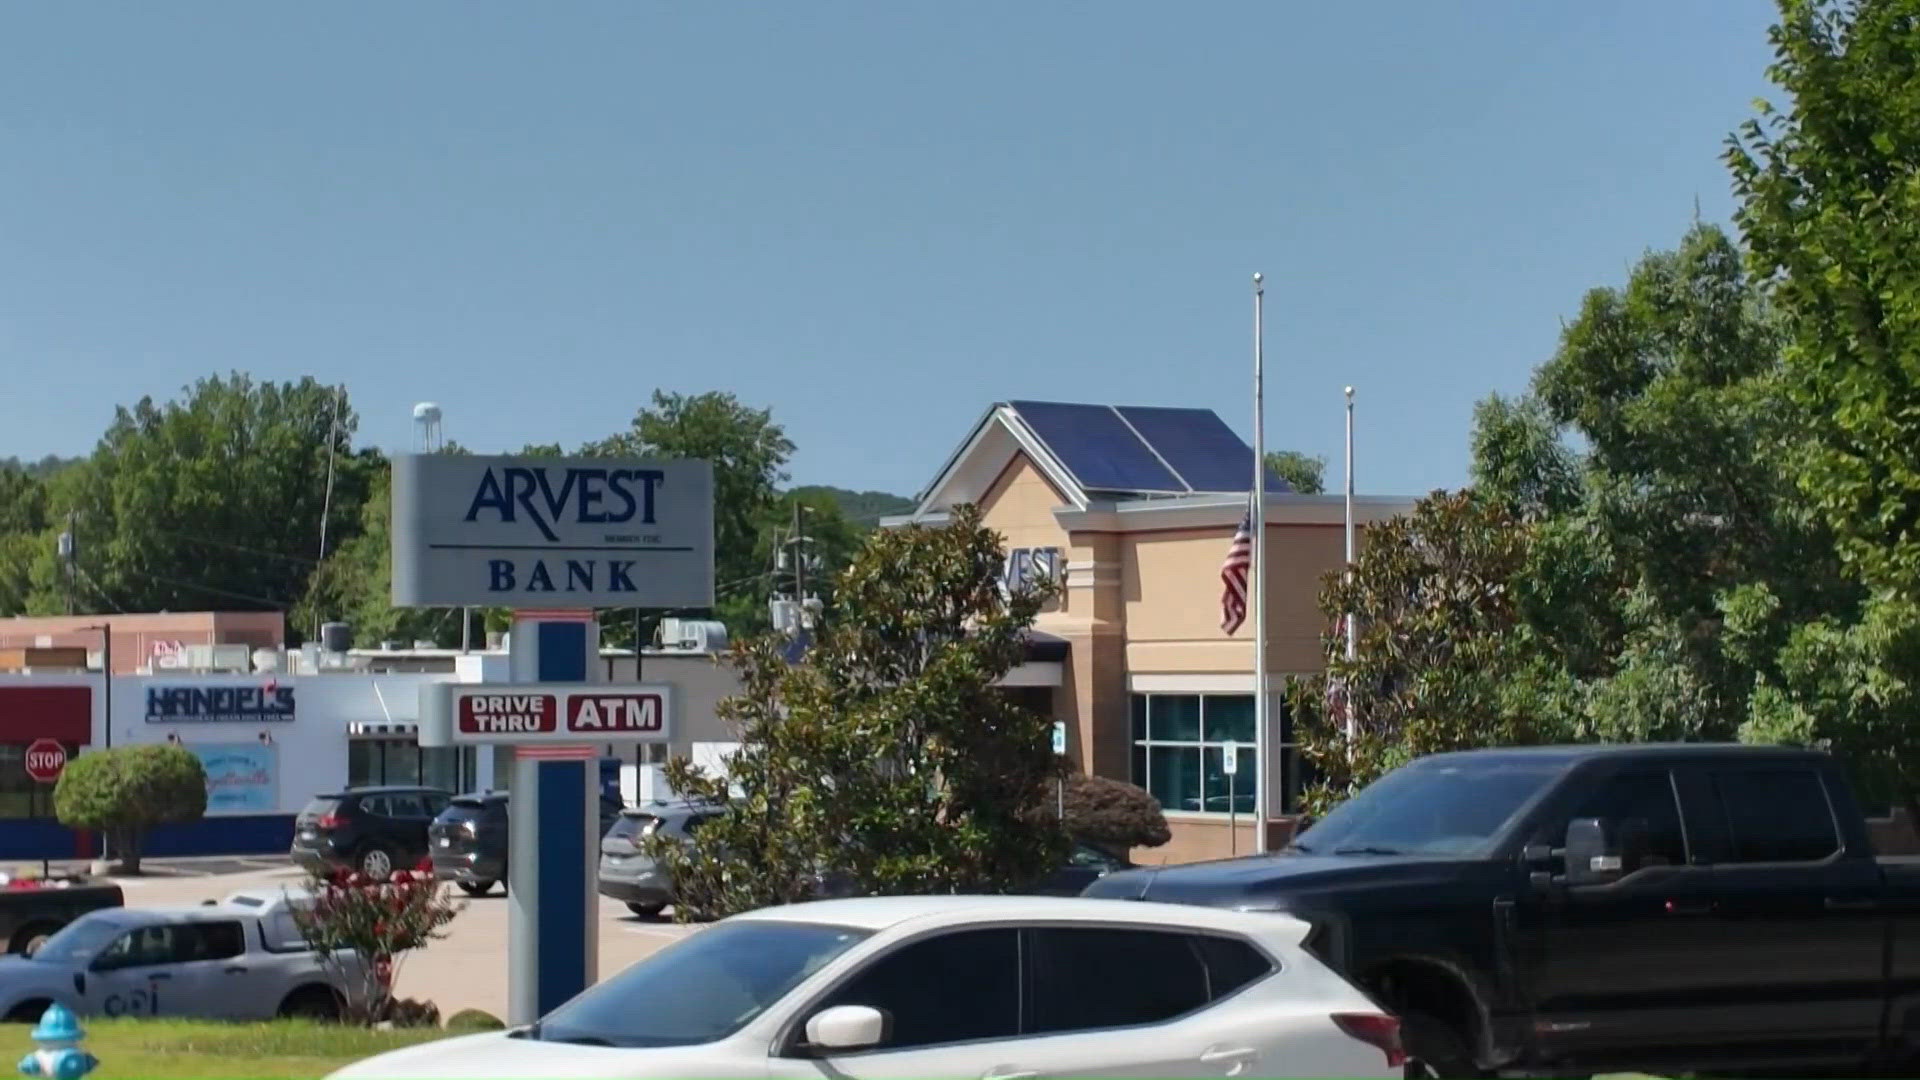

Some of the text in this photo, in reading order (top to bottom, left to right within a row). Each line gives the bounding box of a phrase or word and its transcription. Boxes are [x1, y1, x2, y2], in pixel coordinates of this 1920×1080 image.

[464, 466, 664, 542] ARVEST
[488, 559, 638, 592] BANK
[471, 696, 544, 713] DRIVE
[575, 698, 656, 728] ATM
[474, 714, 541, 732] THRU
[30, 751, 63, 769] STOP
